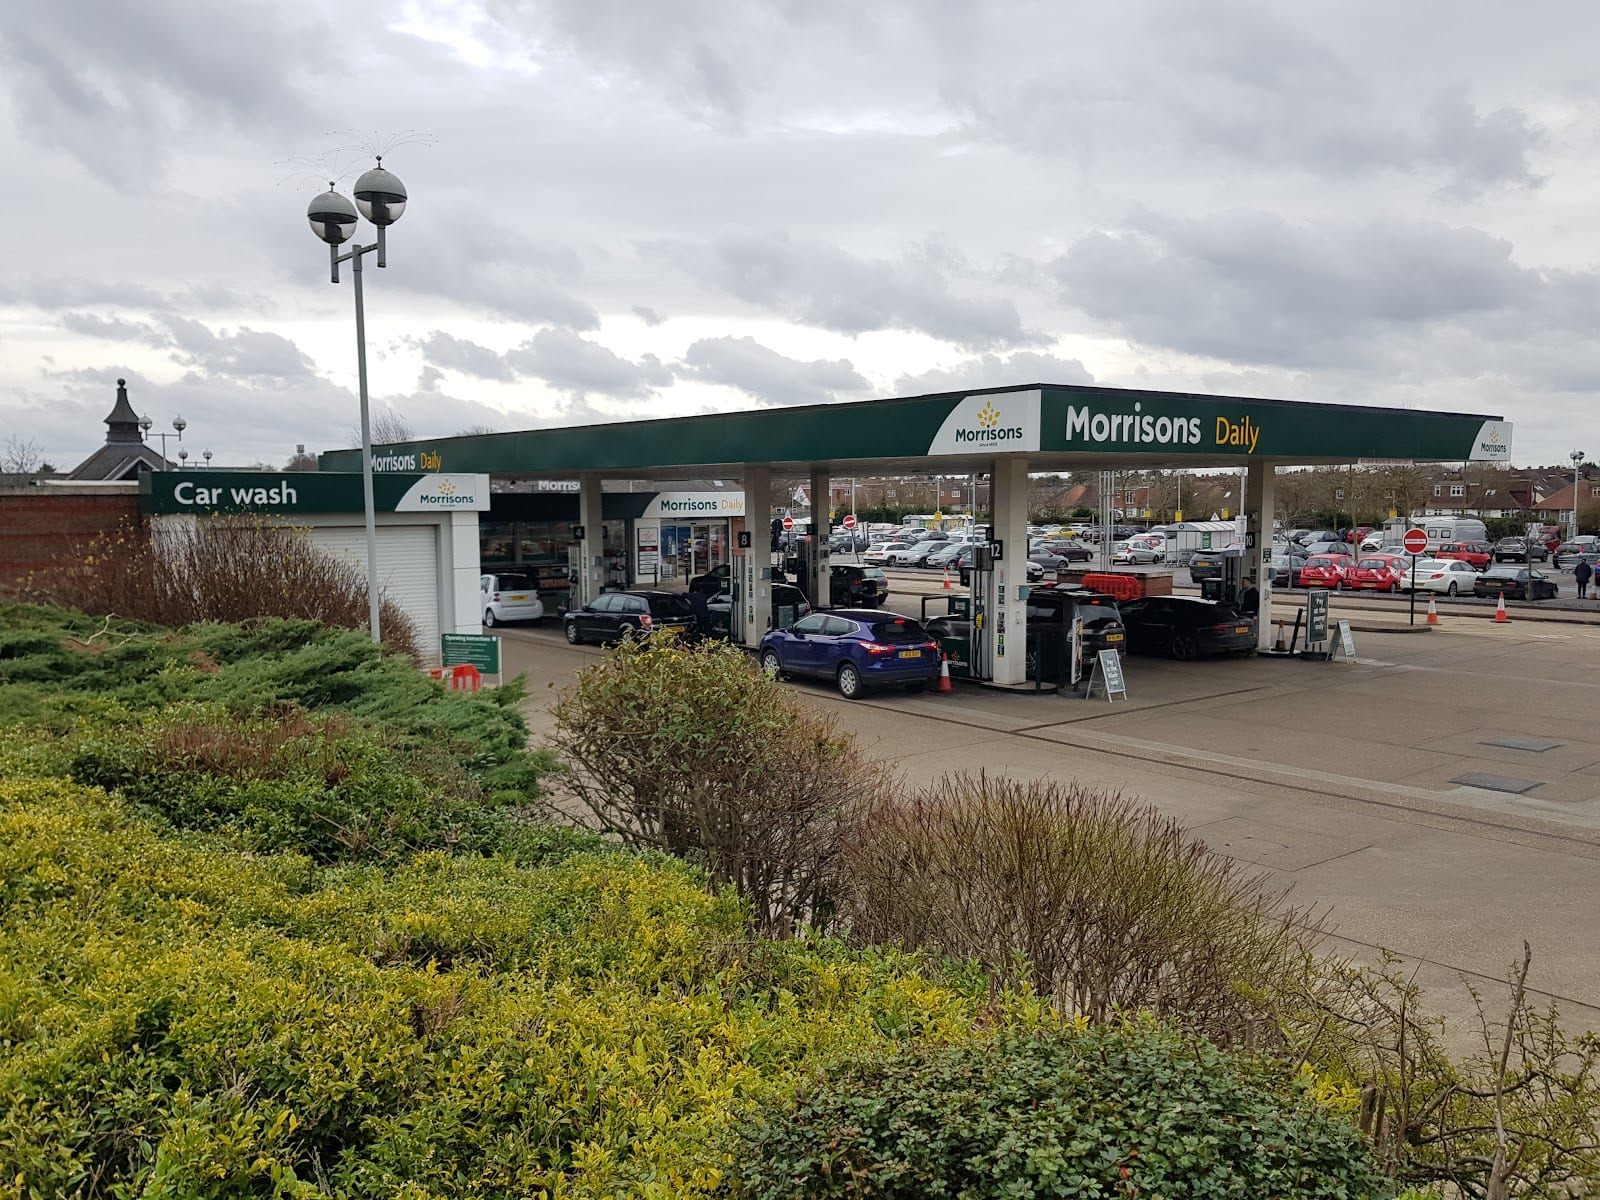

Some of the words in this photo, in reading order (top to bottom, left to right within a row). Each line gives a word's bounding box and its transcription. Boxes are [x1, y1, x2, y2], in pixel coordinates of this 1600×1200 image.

[955, 424, 1023, 442] Morrisons
[1065, 402, 1202, 444] Morrisons
[1215, 415, 1260, 454] Daily
[420, 450, 442, 475] Daily
[538, 480, 581, 491] Morris
[174, 481, 222, 505] Car
[230, 480, 297, 505] wash
[420, 493, 474, 504] Morrisons
[661, 498, 717, 511] Morrisons
[721, 499, 743, 511] Daily
[741, 534, 748, 546] 8
[1246, 535, 1253, 546] 10
[990, 543, 1001, 557] 12
